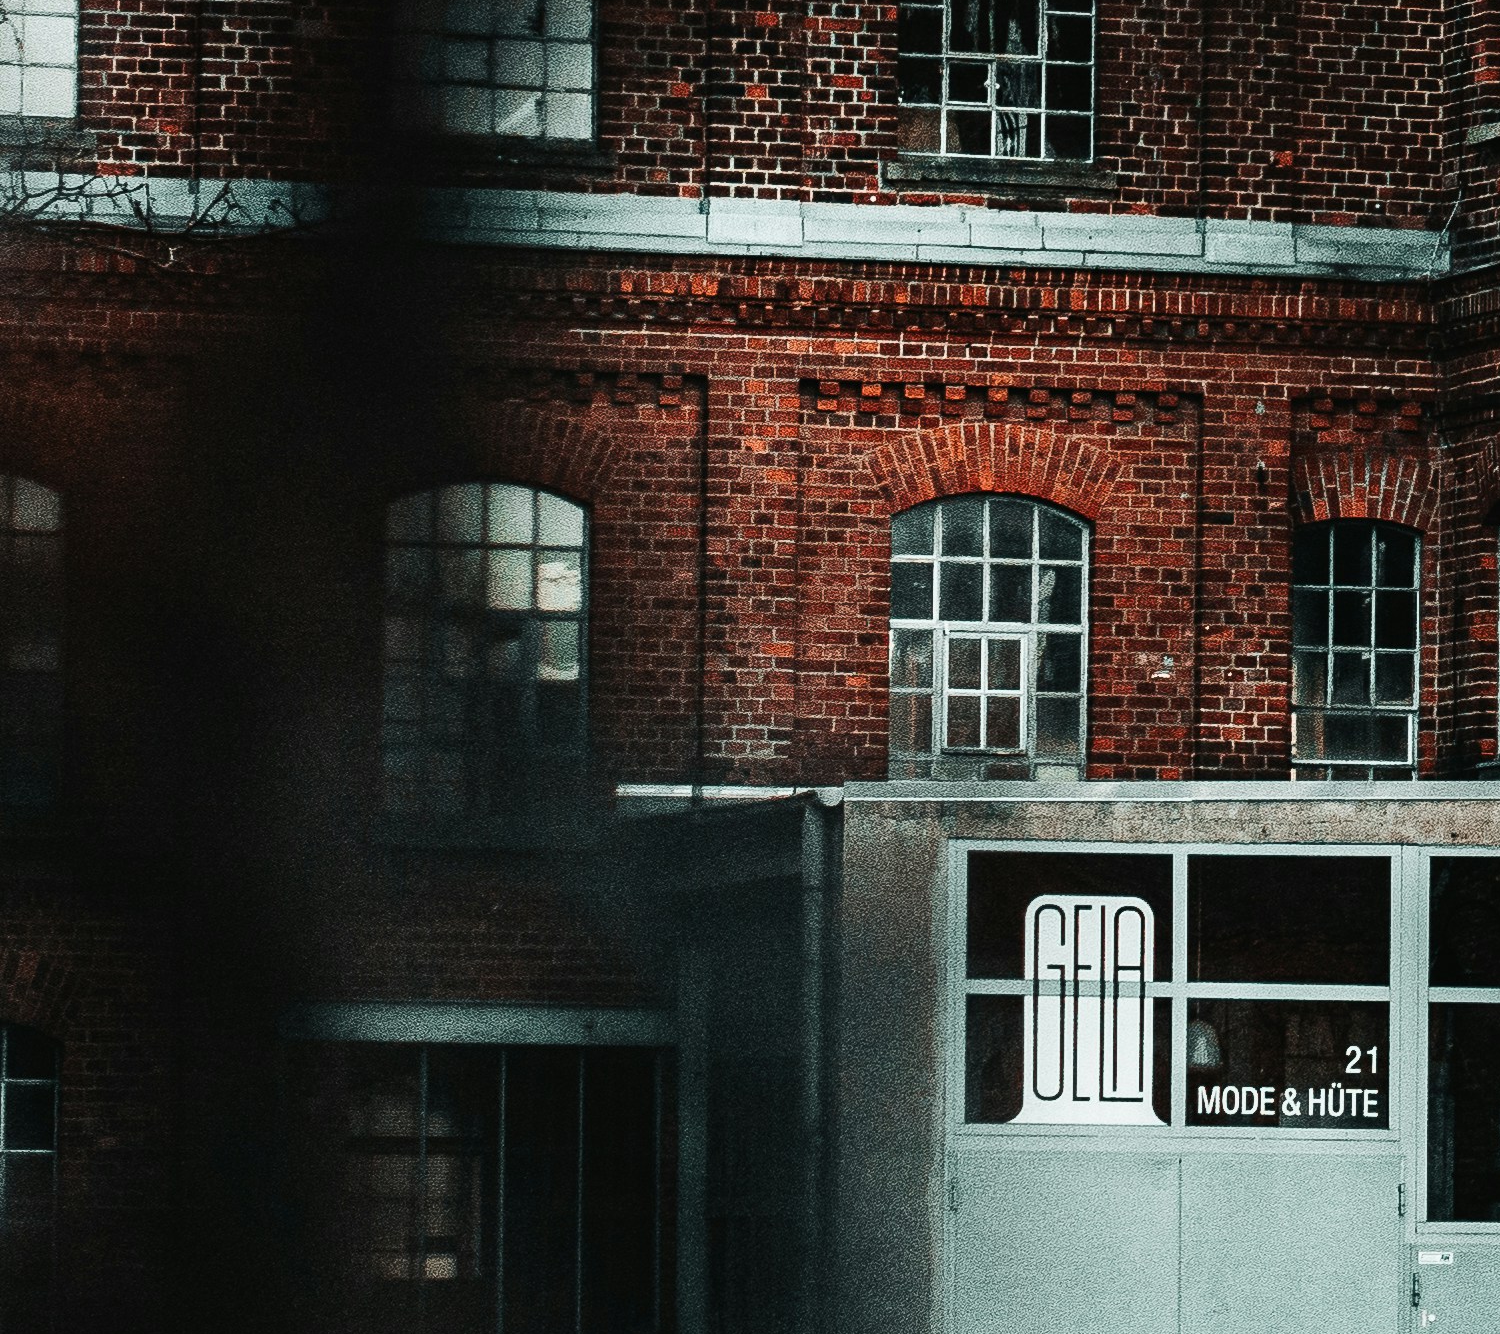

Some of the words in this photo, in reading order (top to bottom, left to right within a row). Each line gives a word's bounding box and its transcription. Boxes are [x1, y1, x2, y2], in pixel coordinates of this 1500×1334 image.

[1033, 903, 1146, 1102] GELA
[1345, 1045, 1379, 1075] 21
[1197, 1085, 1275, 1116] MODE
[1281, 1088, 1301, 1116] &
[1308, 1082, 1379, 1118] HÜTE
